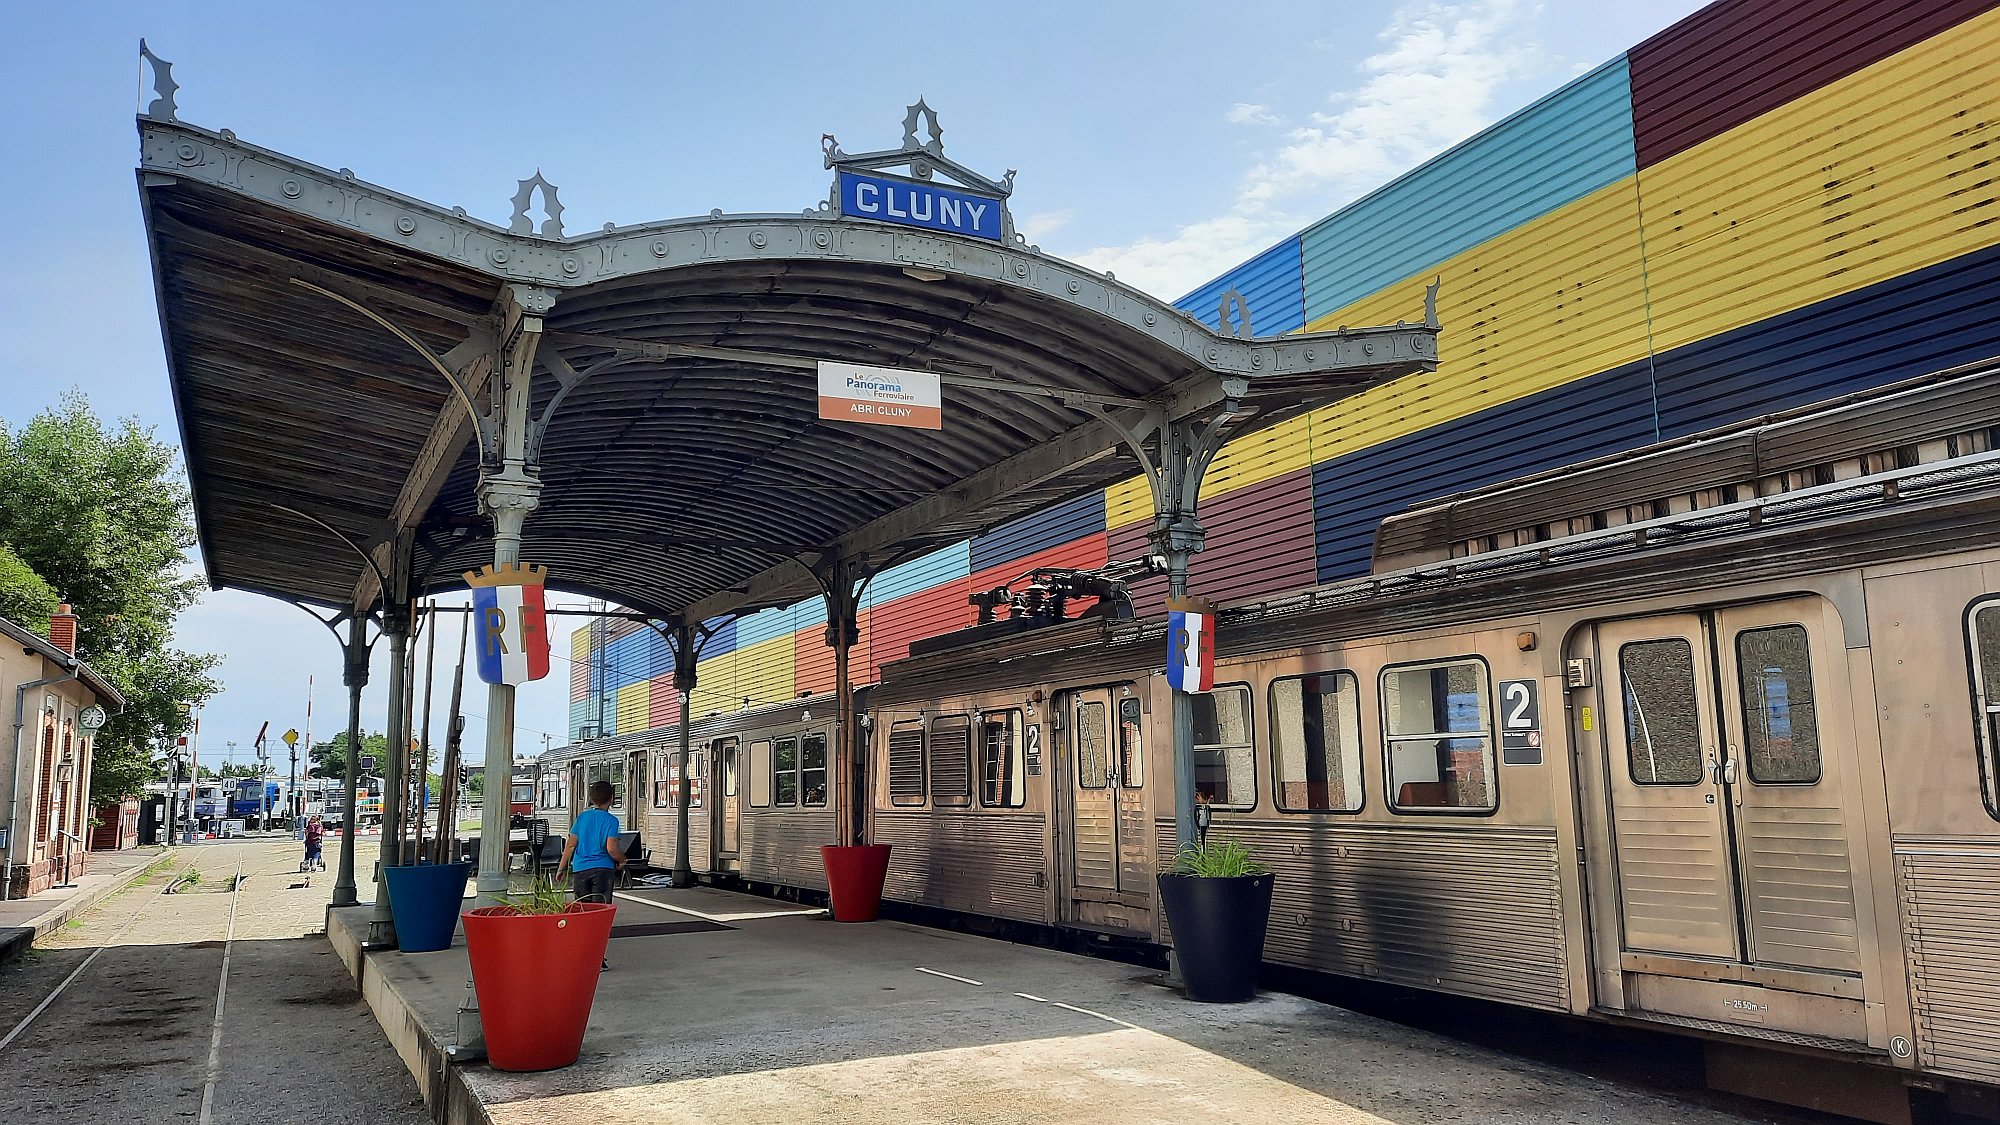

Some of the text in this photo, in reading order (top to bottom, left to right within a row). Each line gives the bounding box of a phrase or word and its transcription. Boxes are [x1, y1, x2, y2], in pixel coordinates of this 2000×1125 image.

[856, 182, 987, 231] CLUNY
[854, 372, 864, 380] Le
[846, 377, 902, 392] Panorama
[873, 390, 915, 400] Ferroviaire
[850, 403, 912, 417] ABRI CLUNY
[1506, 682, 1532, 728] 2
[1028, 725, 1039, 754] 2
[224, 780, 235, 789] 40
[1896, 1040, 1905, 1054] K
